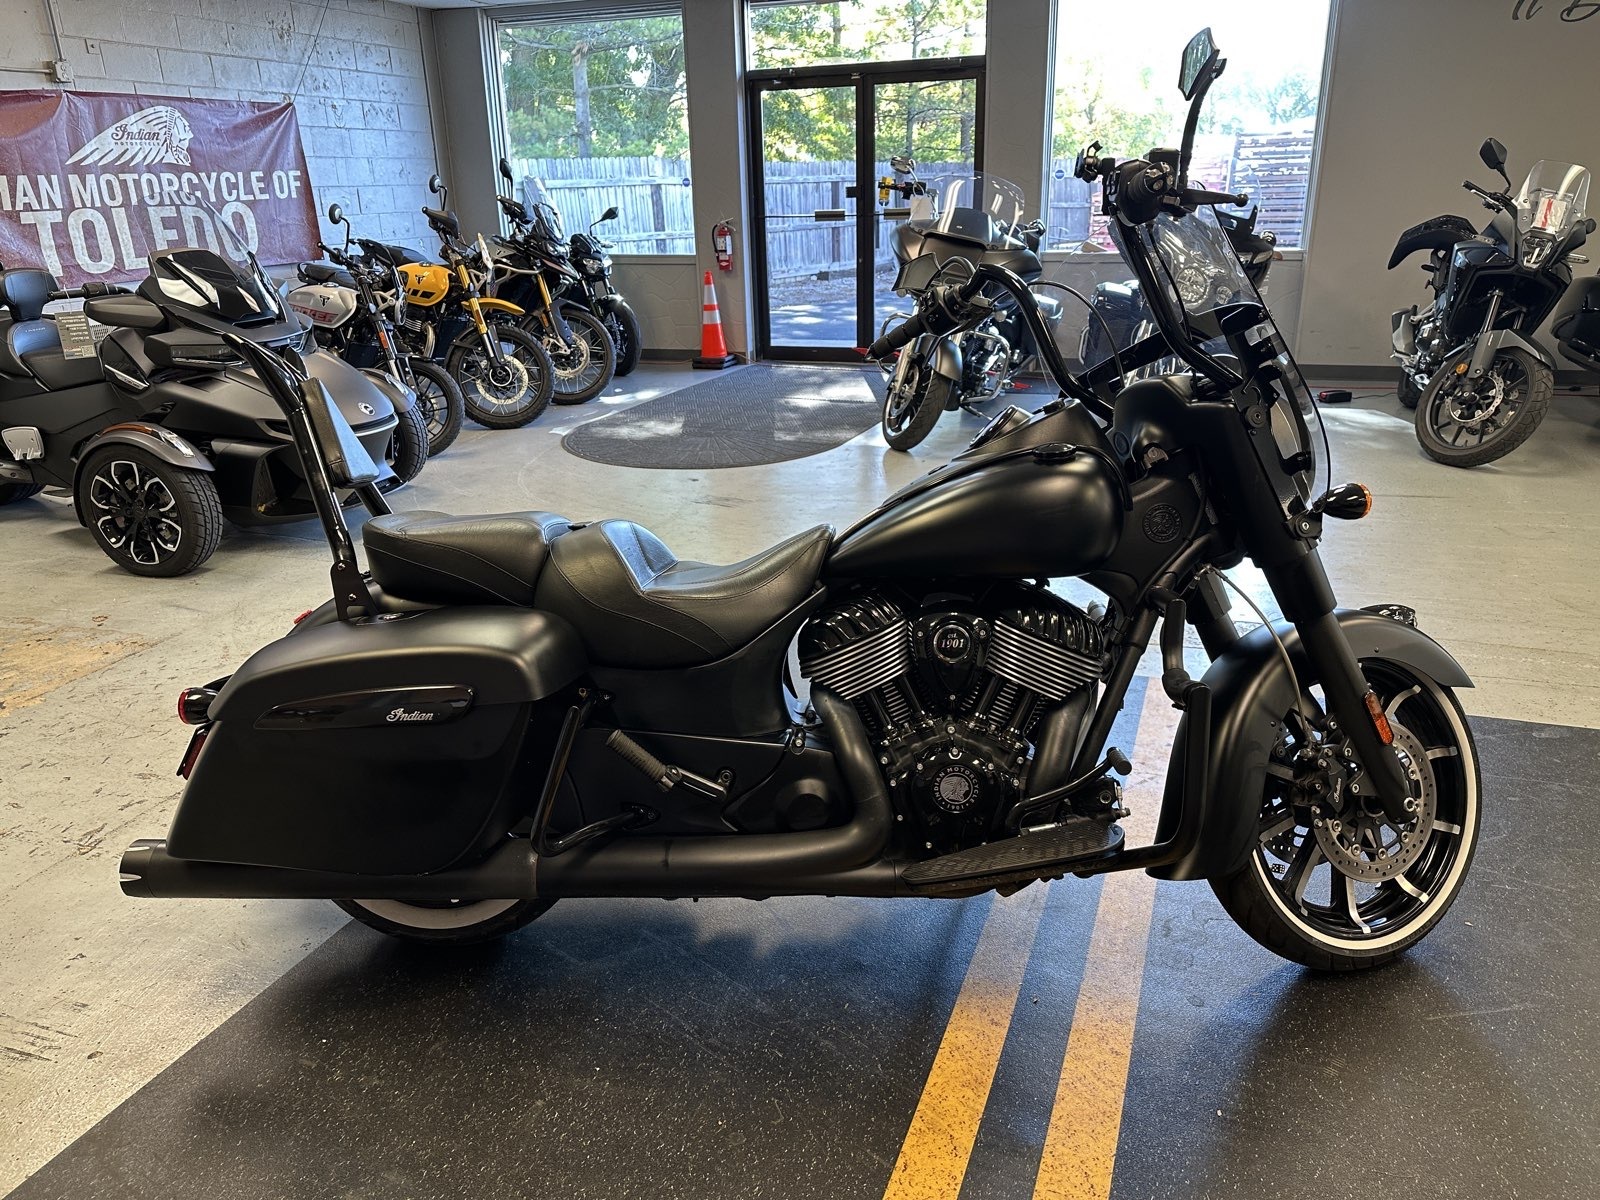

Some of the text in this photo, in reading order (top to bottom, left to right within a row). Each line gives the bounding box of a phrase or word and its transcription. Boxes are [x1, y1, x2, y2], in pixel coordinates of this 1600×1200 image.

[111, 124, 160, 141] Indian
[67, 171, 269, 208] MOTORCYCLE
[272, 169, 301, 199] OF
[20, 201, 259, 278] TOLEDO
[941, 639, 965, 649] 1901
[386, 708, 434, 722] Indian
[933, 766, 980, 804] INDIAN MOTORCYCLE
